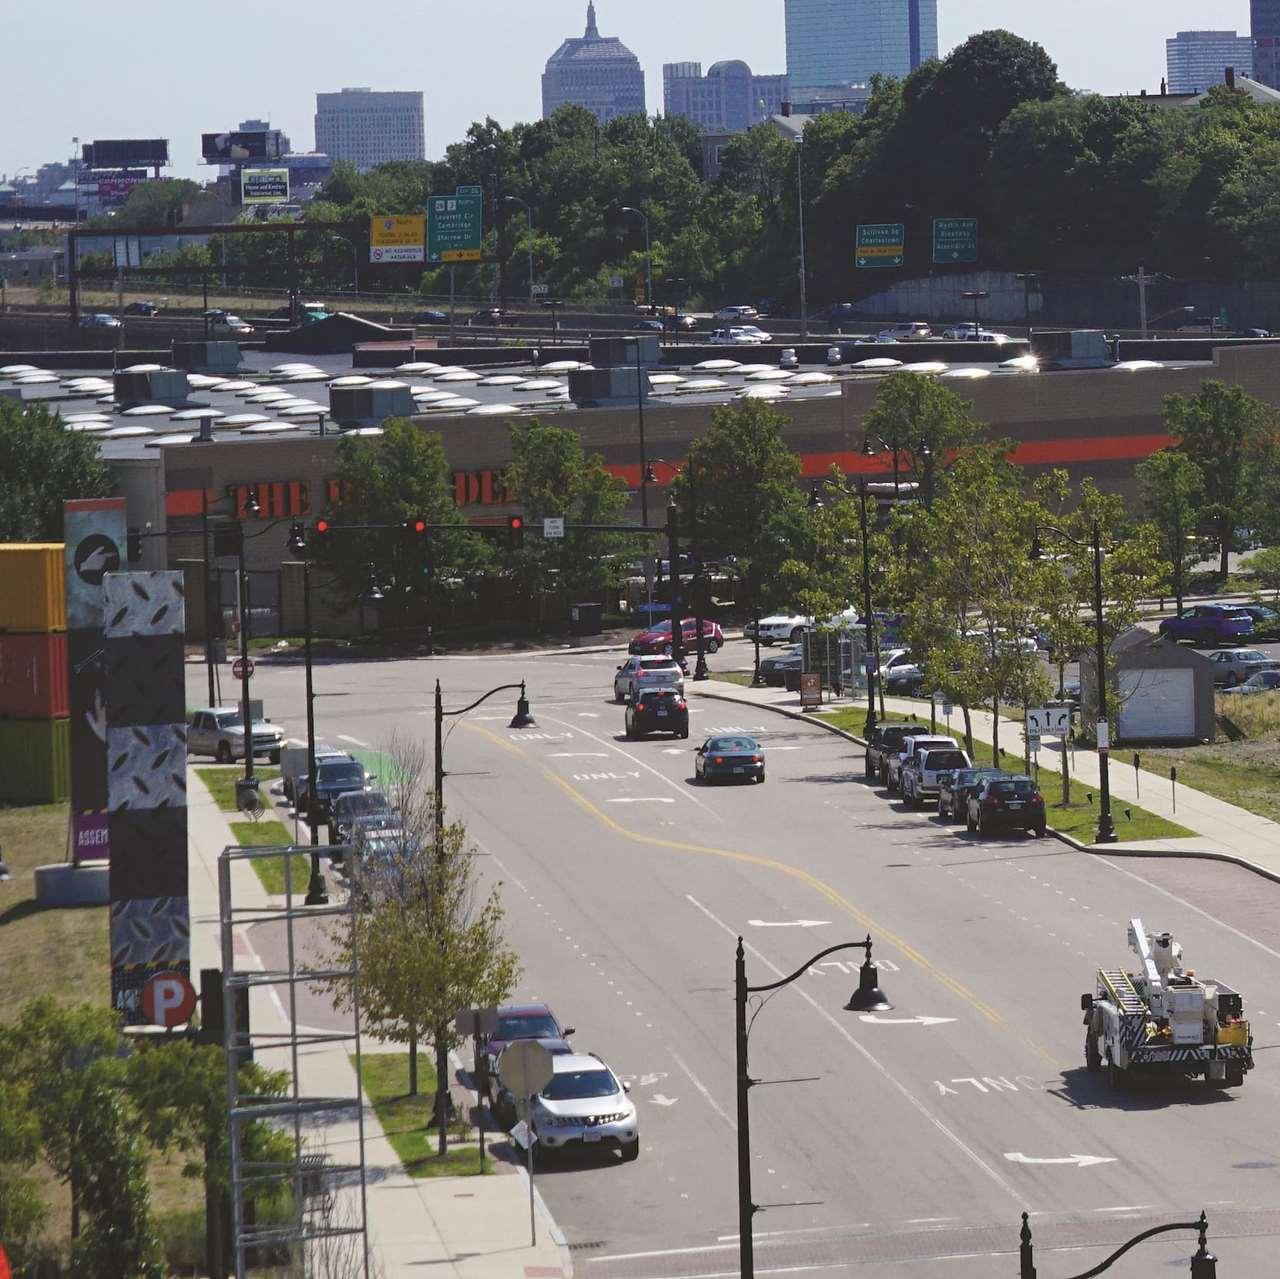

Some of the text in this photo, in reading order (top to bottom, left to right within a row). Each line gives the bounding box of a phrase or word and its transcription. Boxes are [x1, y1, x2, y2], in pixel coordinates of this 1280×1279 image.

[573, 771, 641, 780] ONLY
[153, 981, 185, 1026] P
[933, 1076, 1044, 1096] ONLY
